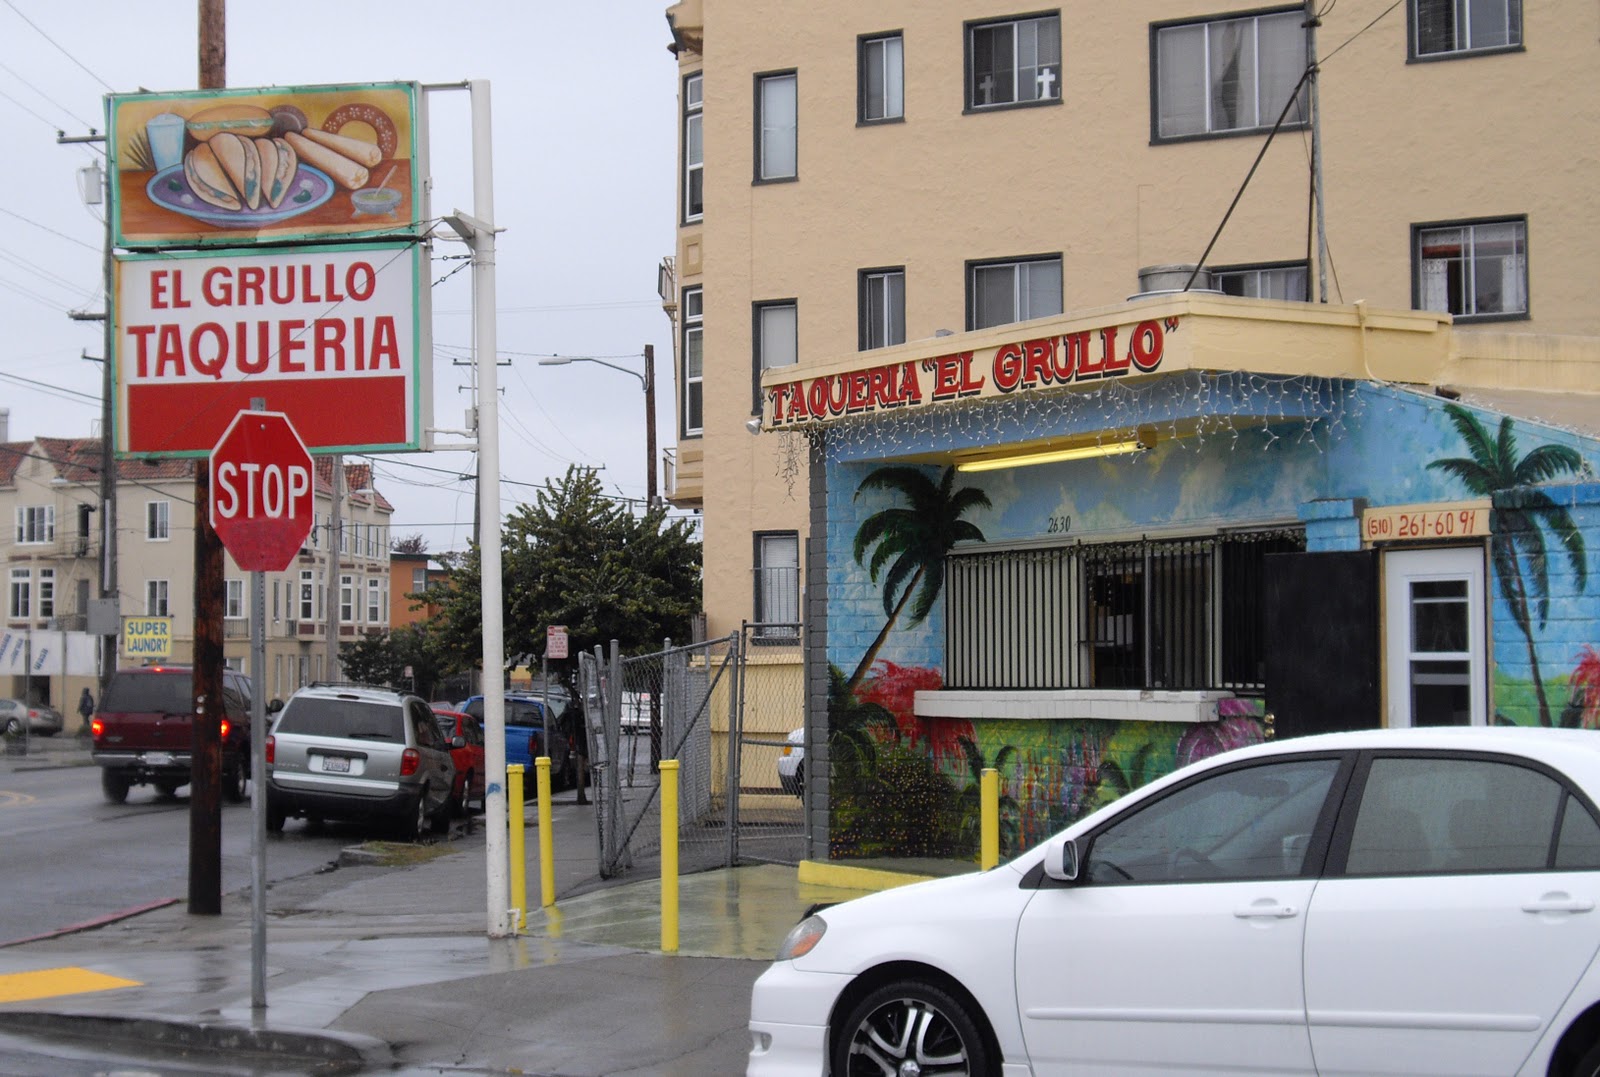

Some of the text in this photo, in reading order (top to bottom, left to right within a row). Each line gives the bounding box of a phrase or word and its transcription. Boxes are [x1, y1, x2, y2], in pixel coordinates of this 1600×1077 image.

[150, 261, 376, 310] EL GRULLO
[126, 315, 401, 381] TAQUERIA
[768, 360, 923, 427] TAQUERIA
[216, 461, 309, 520] STOP
[1047, 515, 1071, 533] 2630
[1367, 515, 1393, 539] (510)
[127, 621, 168, 636] SUPER
[127, 637, 168, 652] LAUNDRY
